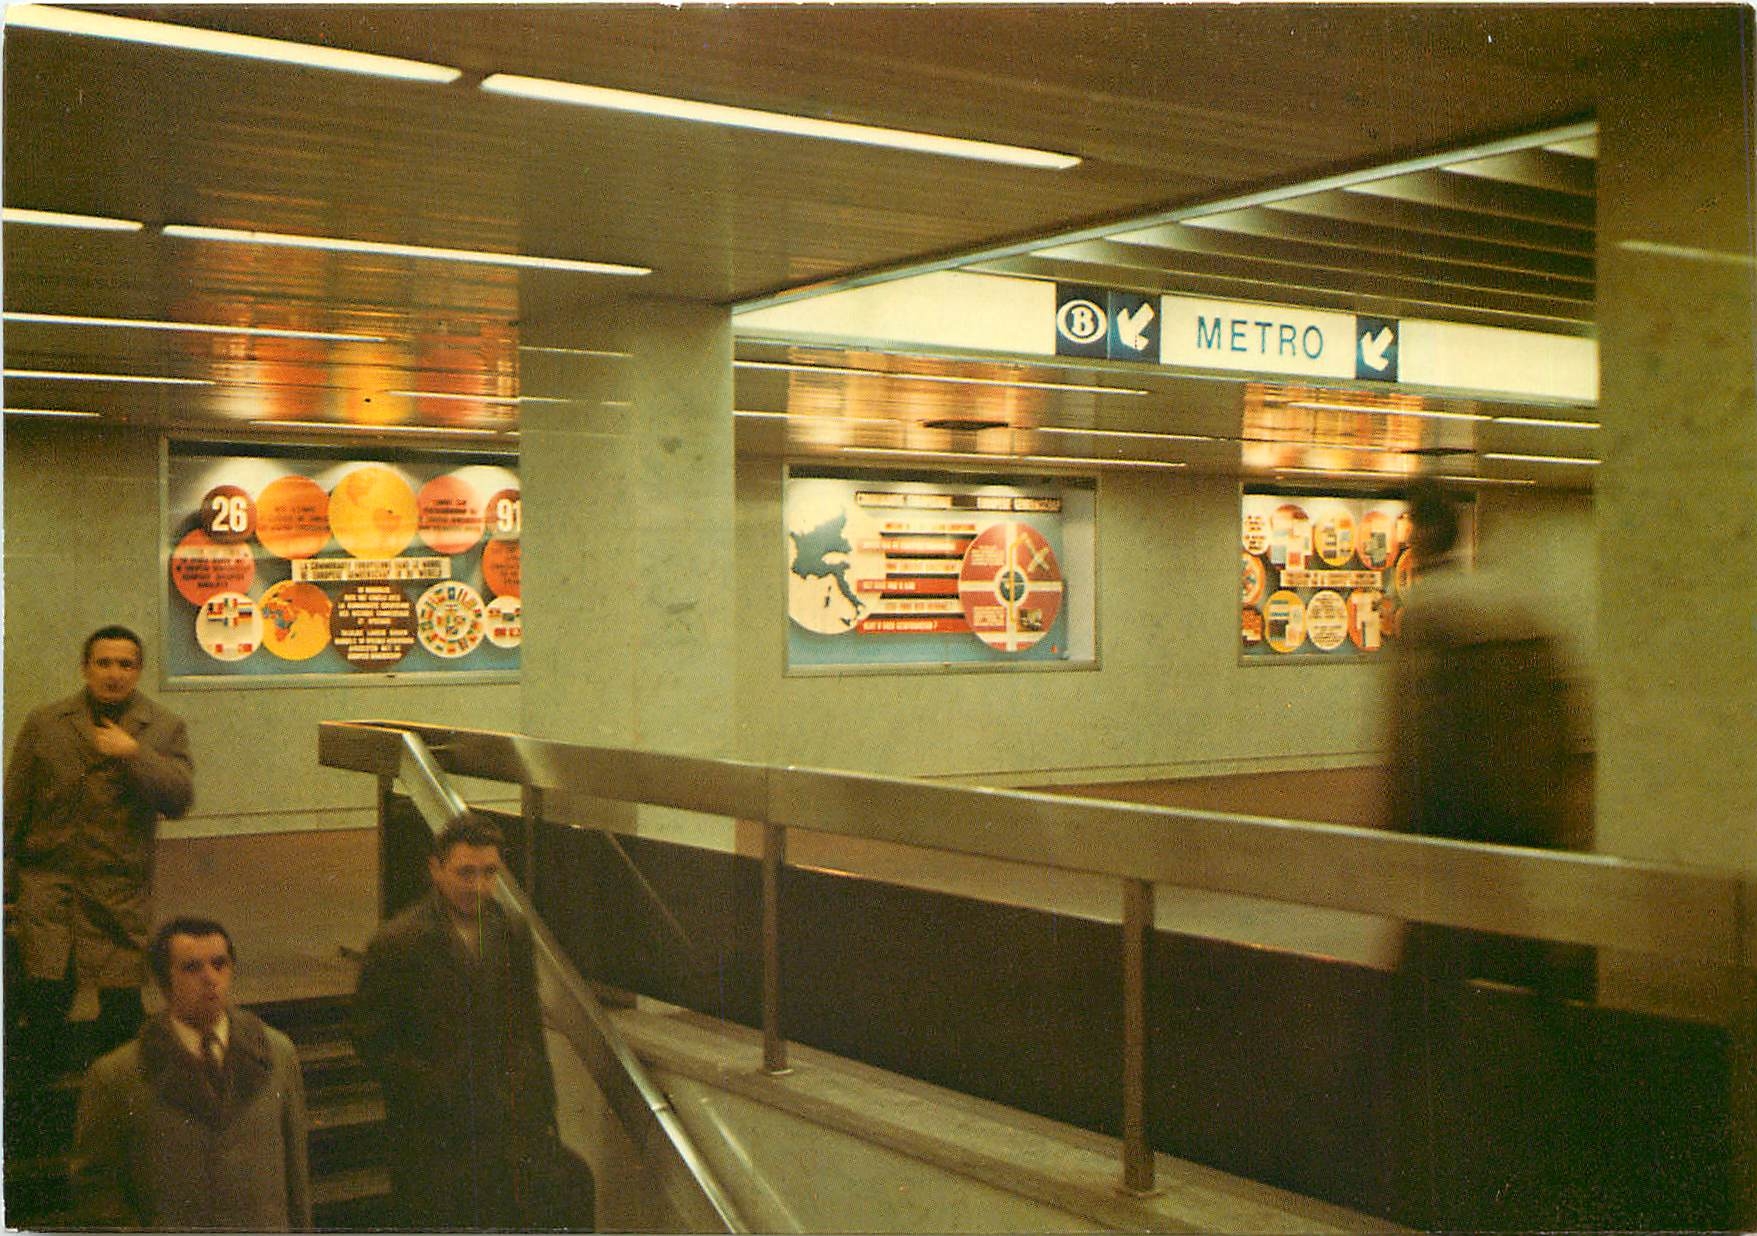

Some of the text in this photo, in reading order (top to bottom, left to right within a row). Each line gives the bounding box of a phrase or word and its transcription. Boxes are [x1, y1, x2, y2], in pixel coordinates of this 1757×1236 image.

[1197, 315, 1323, 359] METRO
[211, 495, 248, 532] 26
[497, 499, 521, 532] 91
